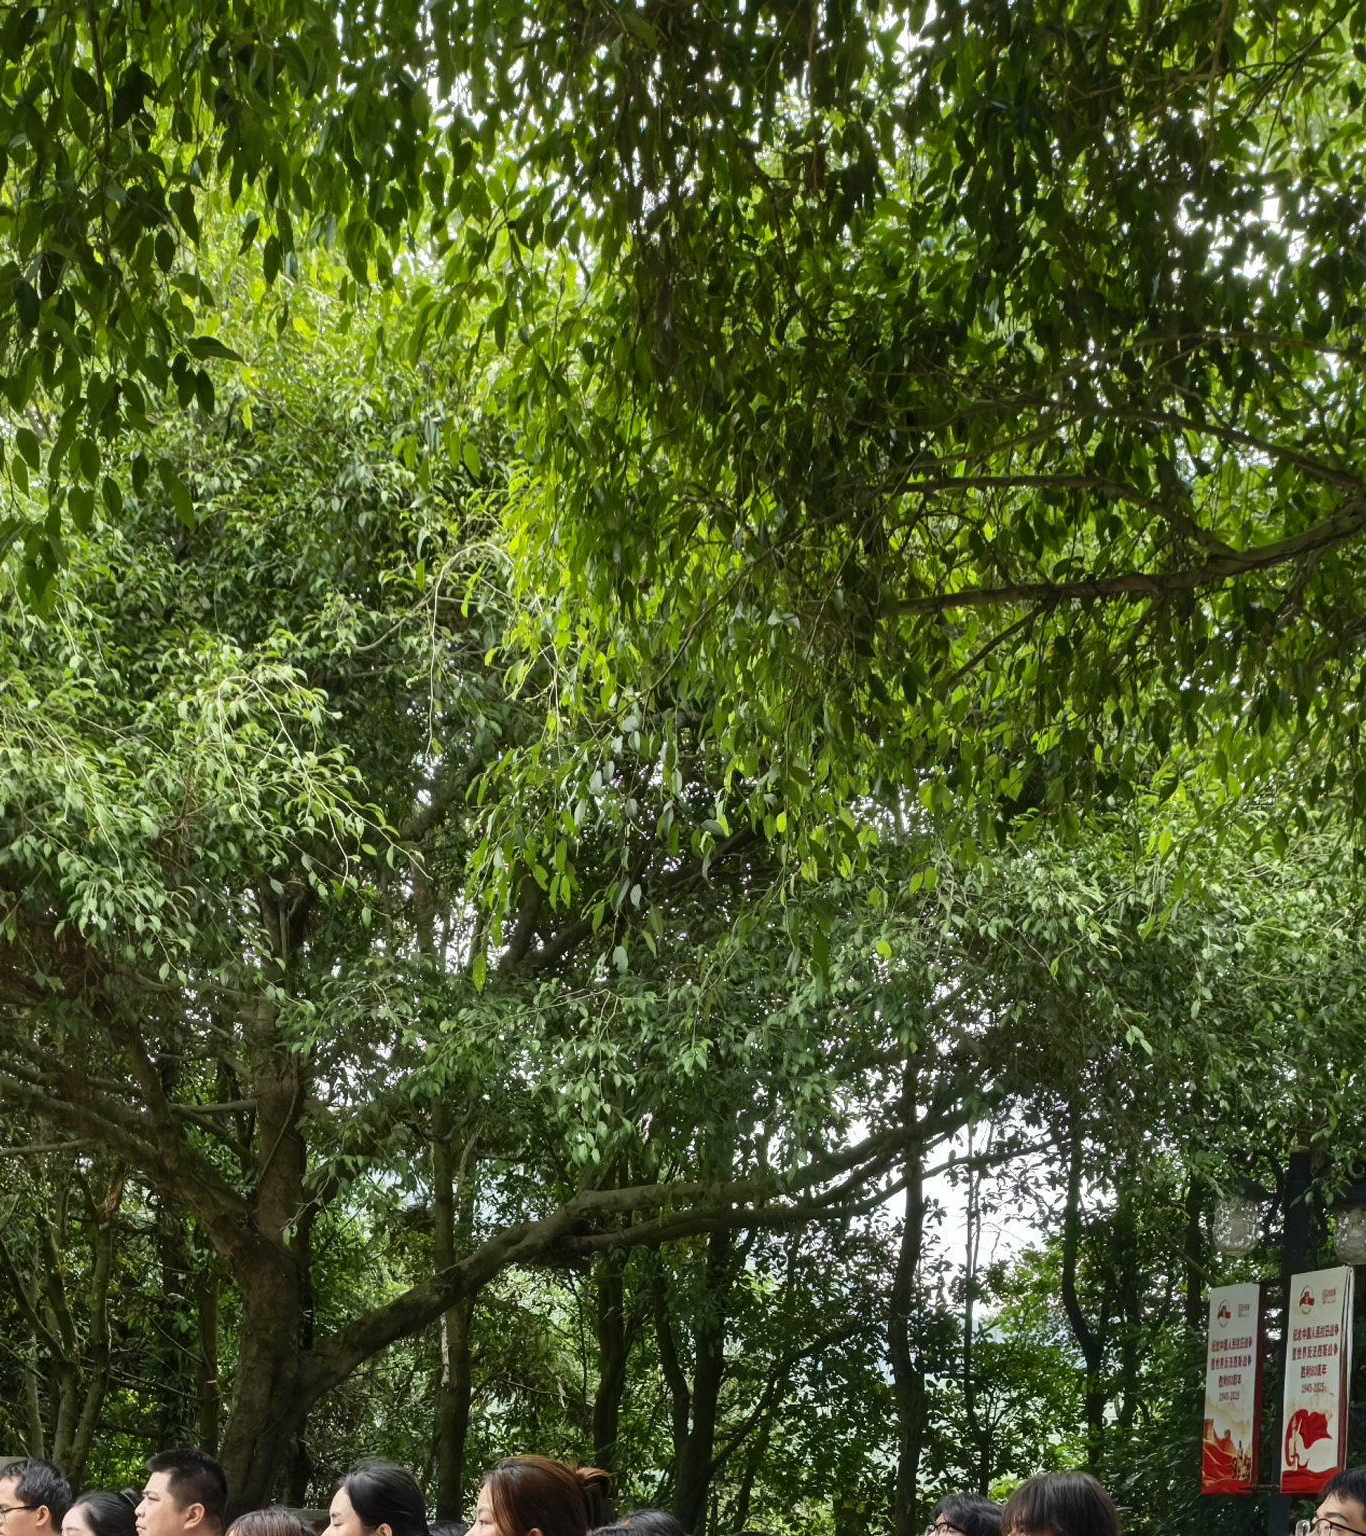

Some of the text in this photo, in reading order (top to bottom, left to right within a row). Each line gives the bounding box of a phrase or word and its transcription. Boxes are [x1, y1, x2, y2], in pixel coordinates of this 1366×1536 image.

[1292, 1323, 1340, 1342] 纪念中国人民抗日战争
